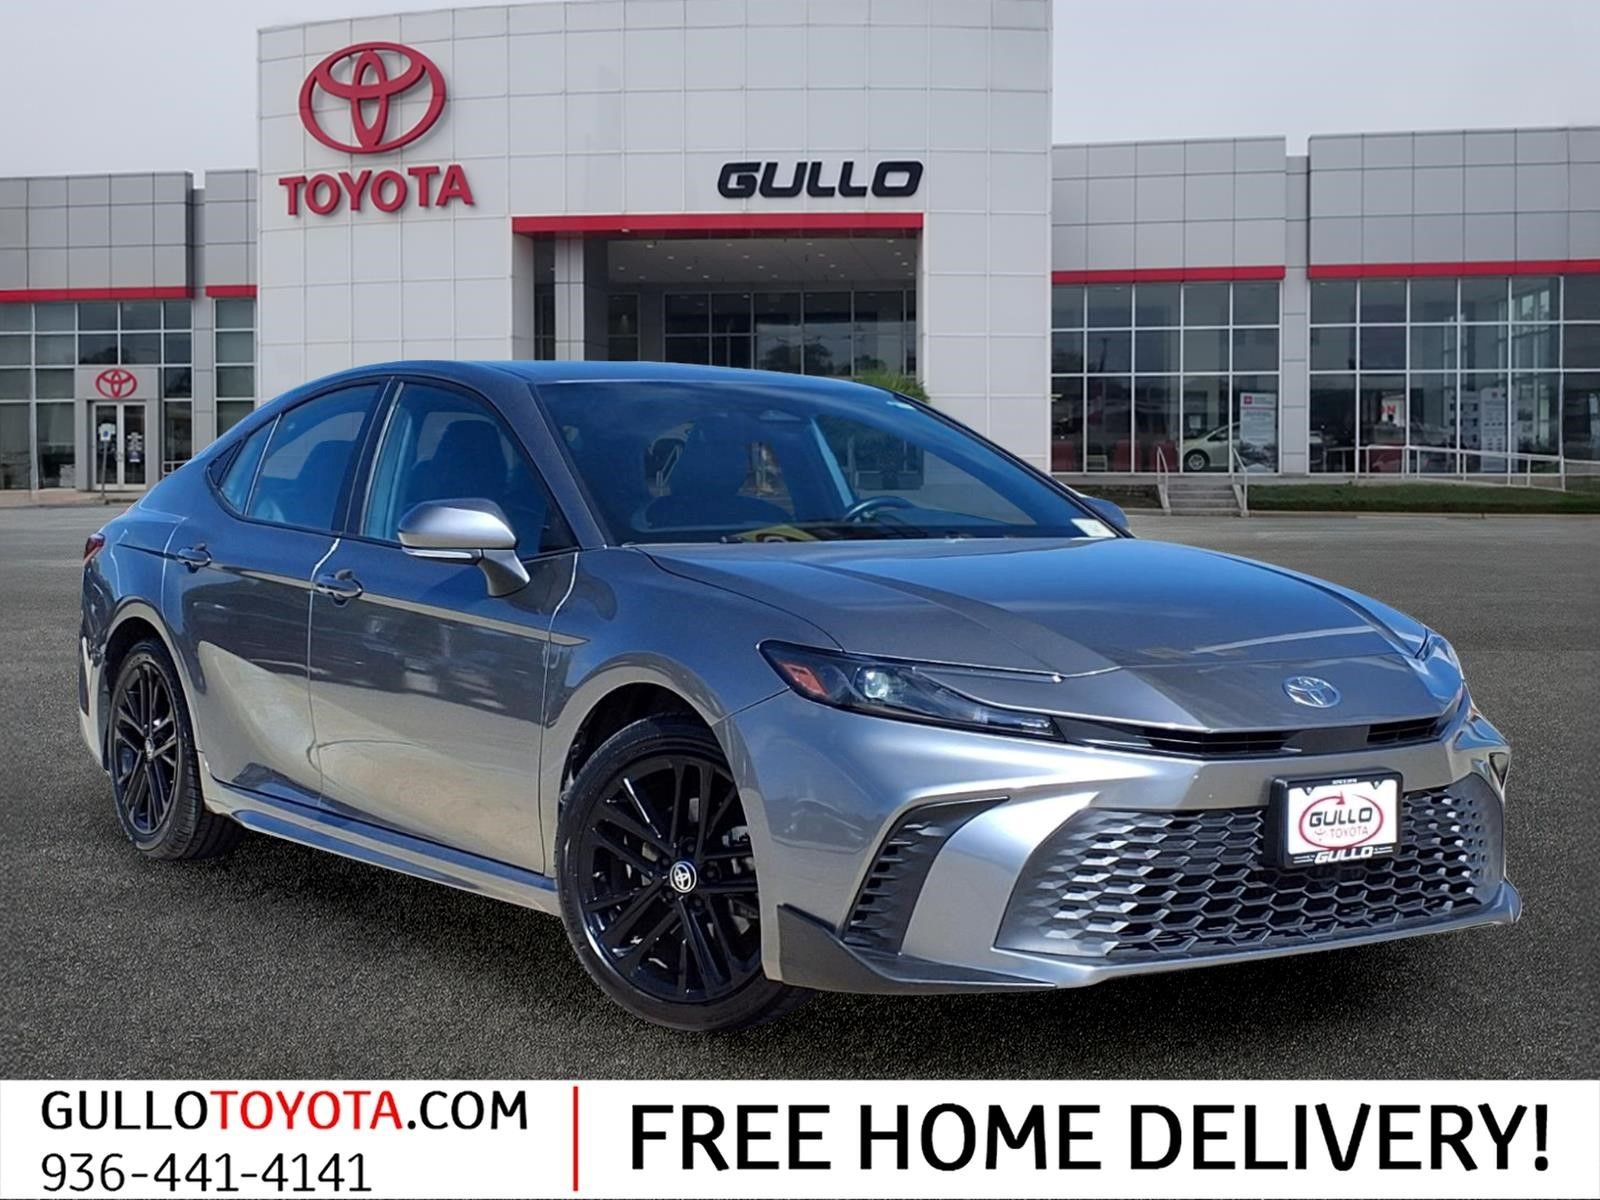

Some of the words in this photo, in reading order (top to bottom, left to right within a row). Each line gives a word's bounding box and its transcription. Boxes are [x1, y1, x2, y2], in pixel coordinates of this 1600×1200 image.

[279, 164, 476, 216] TOYOTA
[718, 161, 924, 199] GULLO
[1309, 807, 1373, 827] GULLO
[1330, 826, 1369, 838] TOYOTA
[1315, 846, 1374, 864] GULLO
